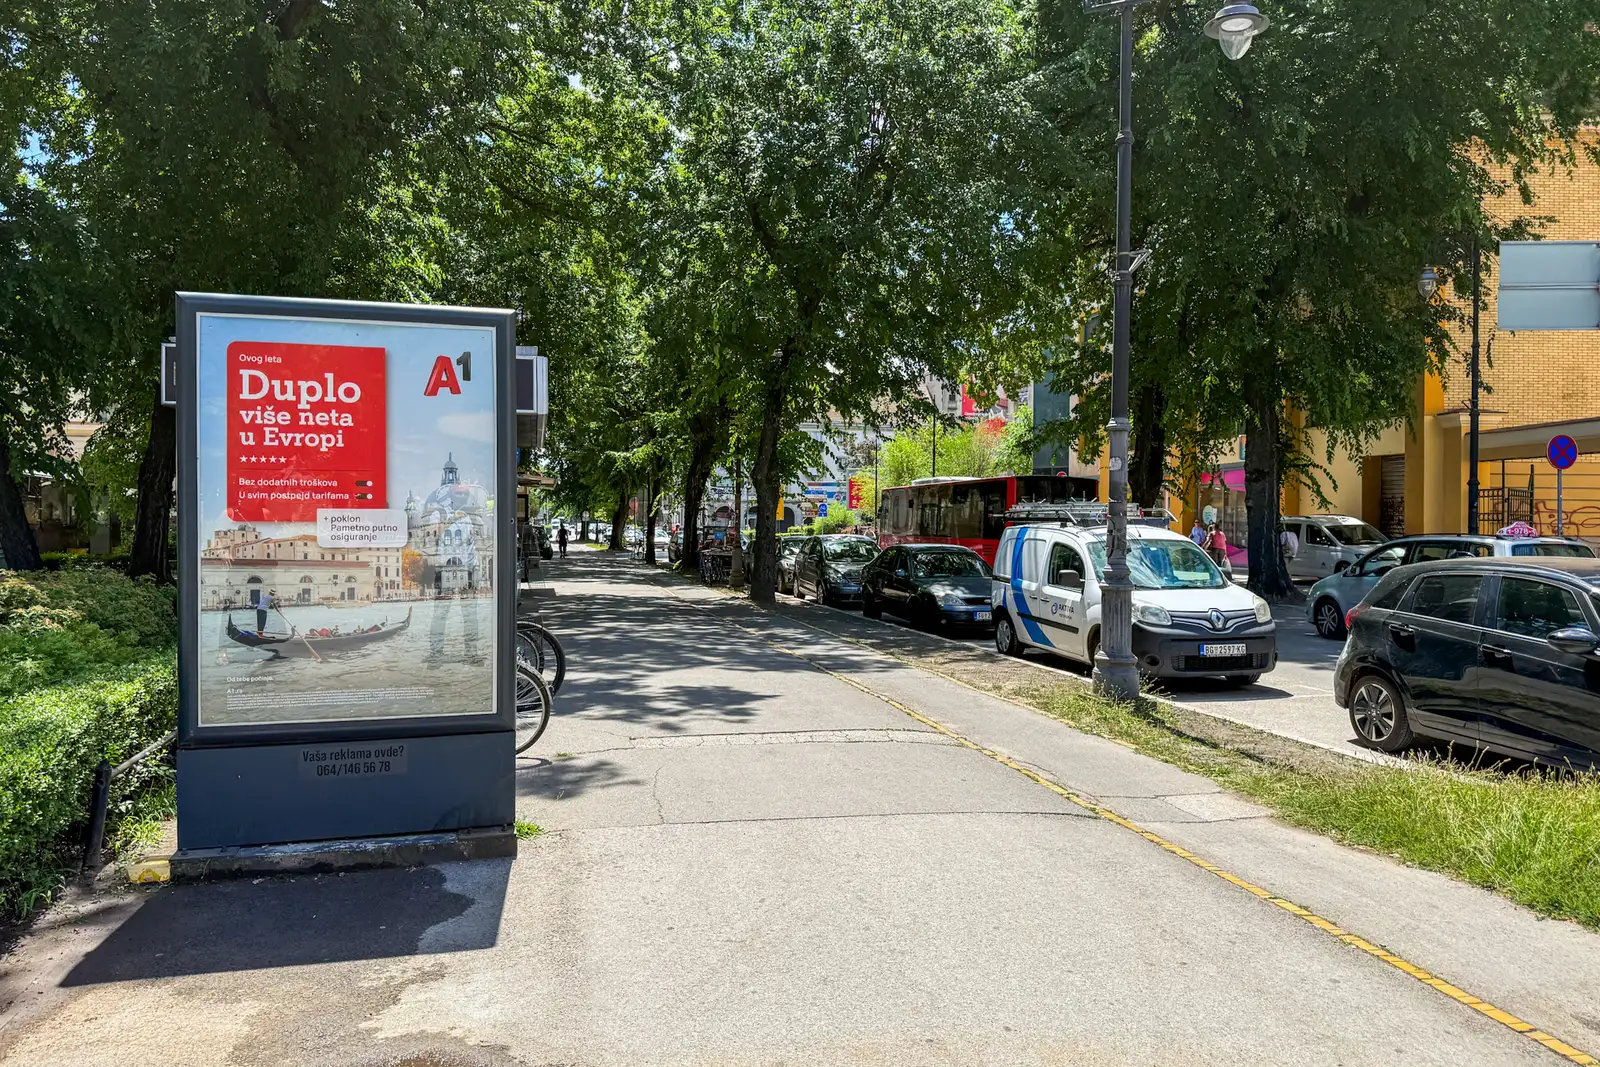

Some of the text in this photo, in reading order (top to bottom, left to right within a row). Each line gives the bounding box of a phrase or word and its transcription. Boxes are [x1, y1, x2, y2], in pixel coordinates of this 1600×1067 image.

[239, 354, 282, 364] Ovog leta
[424, 351, 471, 396] A1
[239, 369, 361, 409] Duplo
[239, 405, 354, 426] više neta
[239, 427, 345, 452] u Evropi
[239, 477, 338, 487] Bez dodatnih troškova
[239, 491, 349, 501] U svim postpejd tarifama
[330, 514, 361, 524] poklon
[330, 524, 398, 533] Pametno putno
[330, 533, 378, 542] osiguranje
[302, 745, 405, 762] Vaša reklama ovde?
[316, 761, 391, 777] 064/146 56 78
